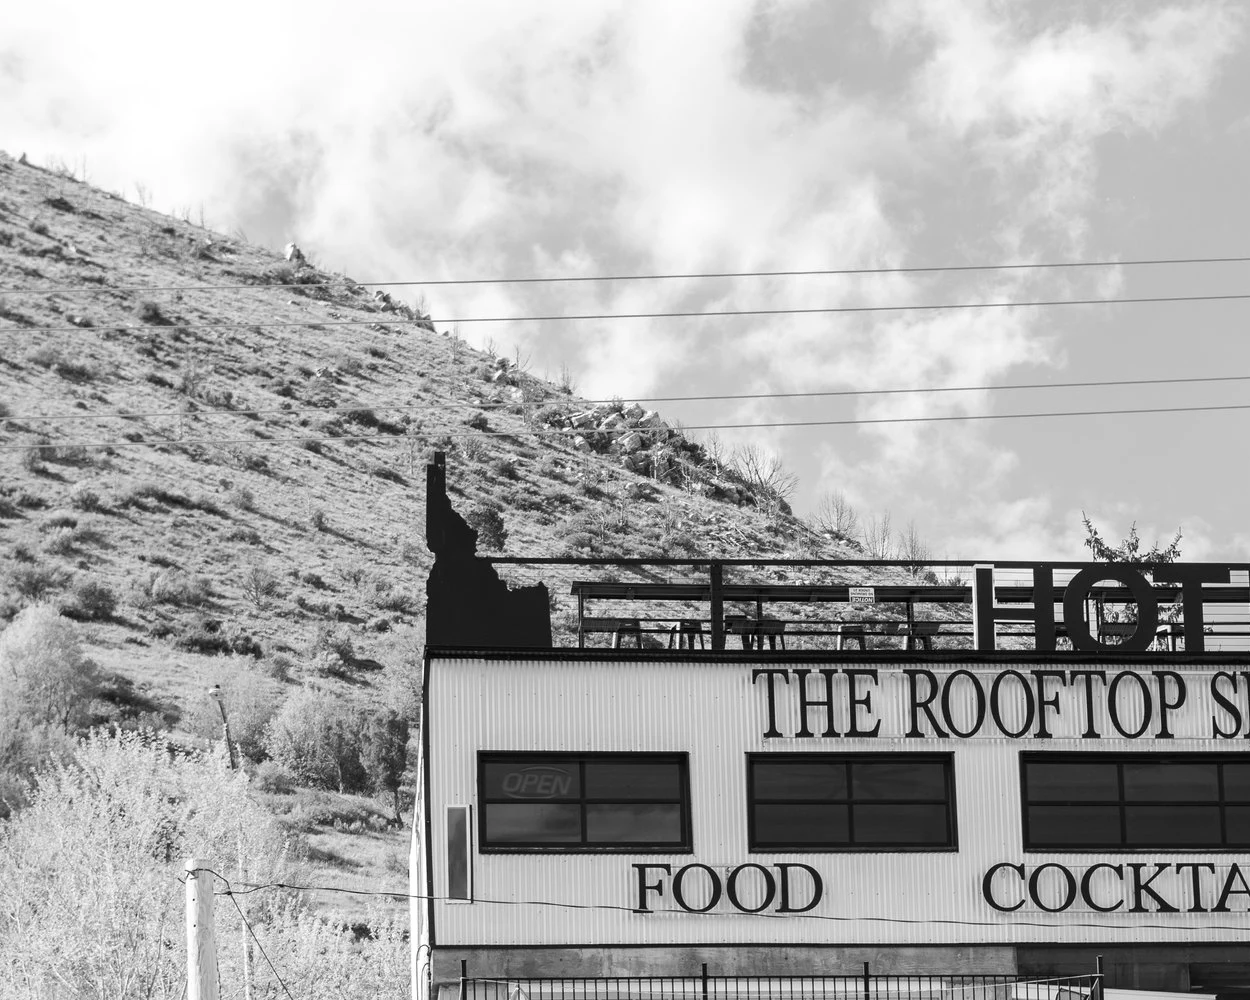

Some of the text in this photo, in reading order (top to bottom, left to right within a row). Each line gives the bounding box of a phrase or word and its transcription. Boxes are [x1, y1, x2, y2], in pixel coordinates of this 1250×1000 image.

[752, 668, 881, 739] THE
[903, 668, 1187, 741] ROOFTOP
[502, 771, 572, 797] OPEN
[632, 862, 824, 915] FOOD
